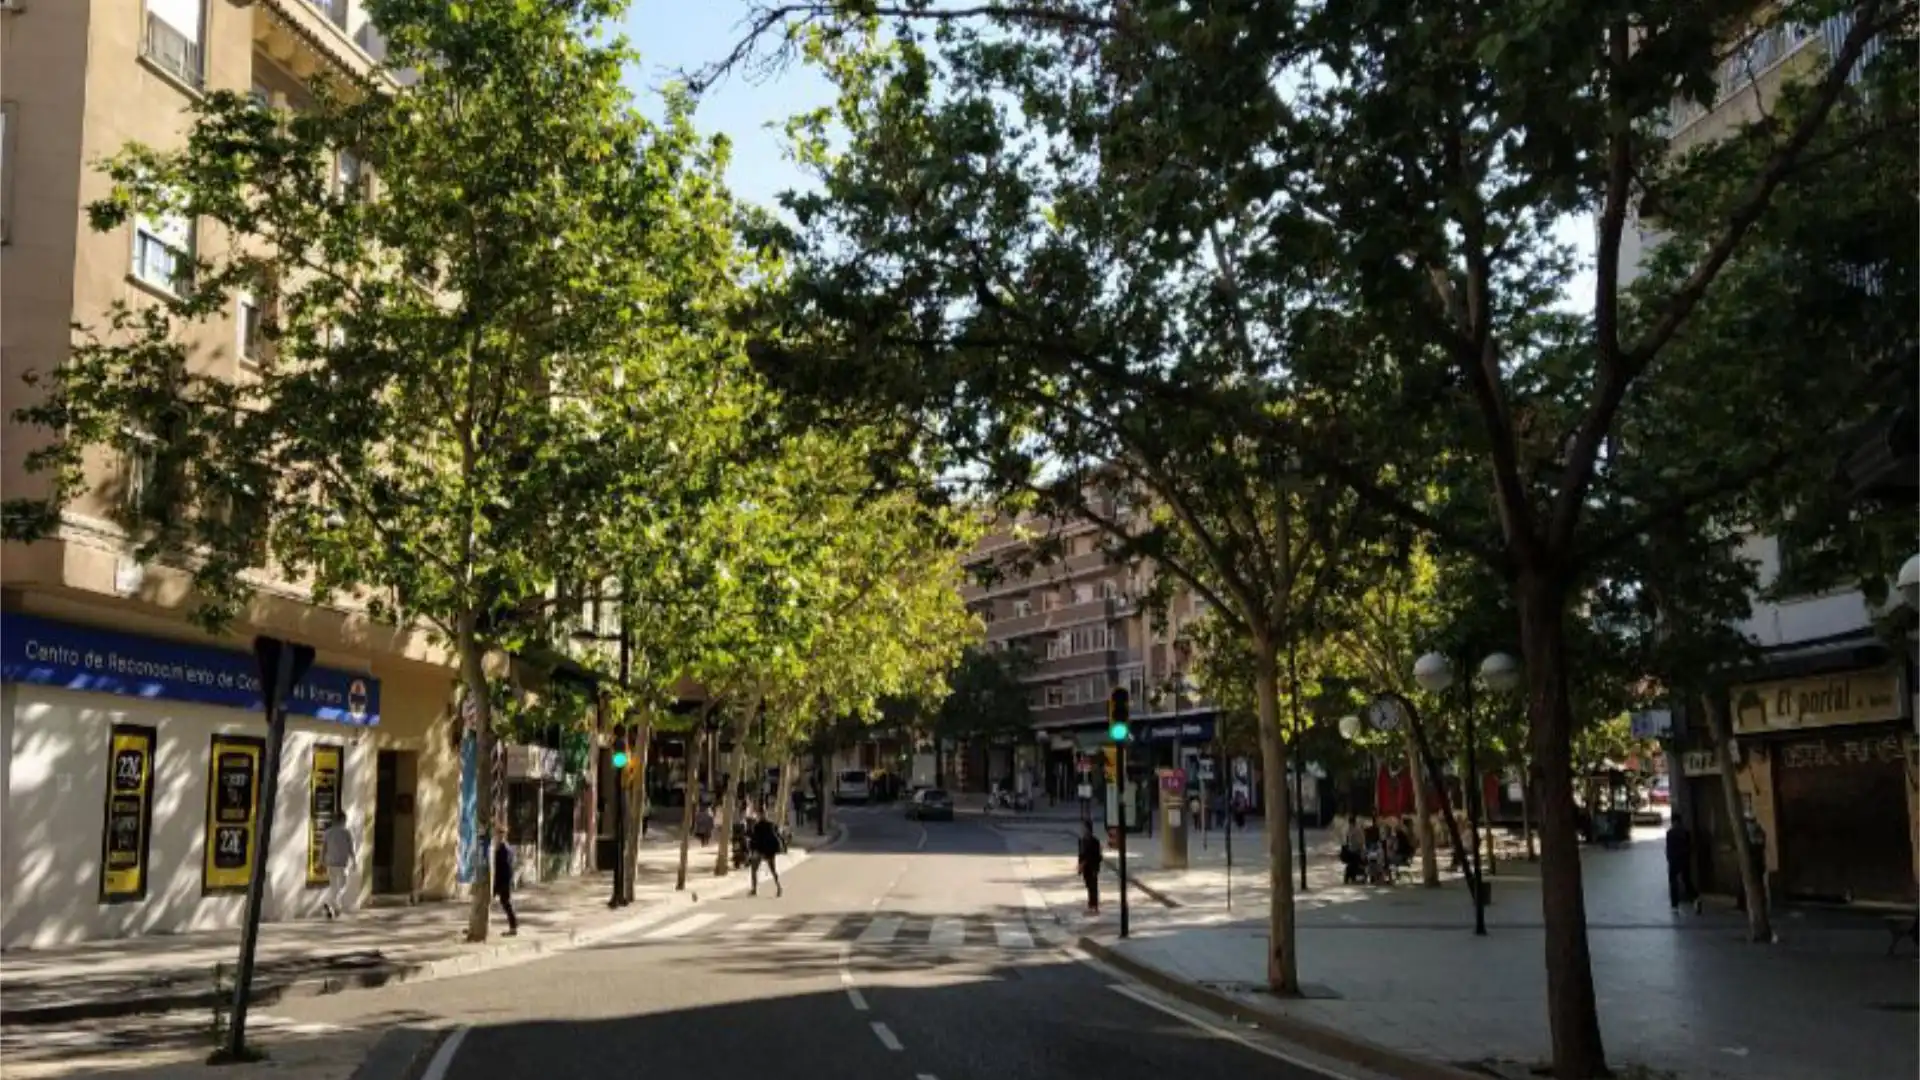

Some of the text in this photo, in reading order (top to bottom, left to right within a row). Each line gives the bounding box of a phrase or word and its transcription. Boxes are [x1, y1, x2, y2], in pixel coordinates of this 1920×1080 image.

[25, 640, 79, 665] Centro
[85, 652, 102, 669] de
[217, 672, 234, 688] de
[1777, 689, 1792, 716] El
[1798, 676, 1850, 723] portal
